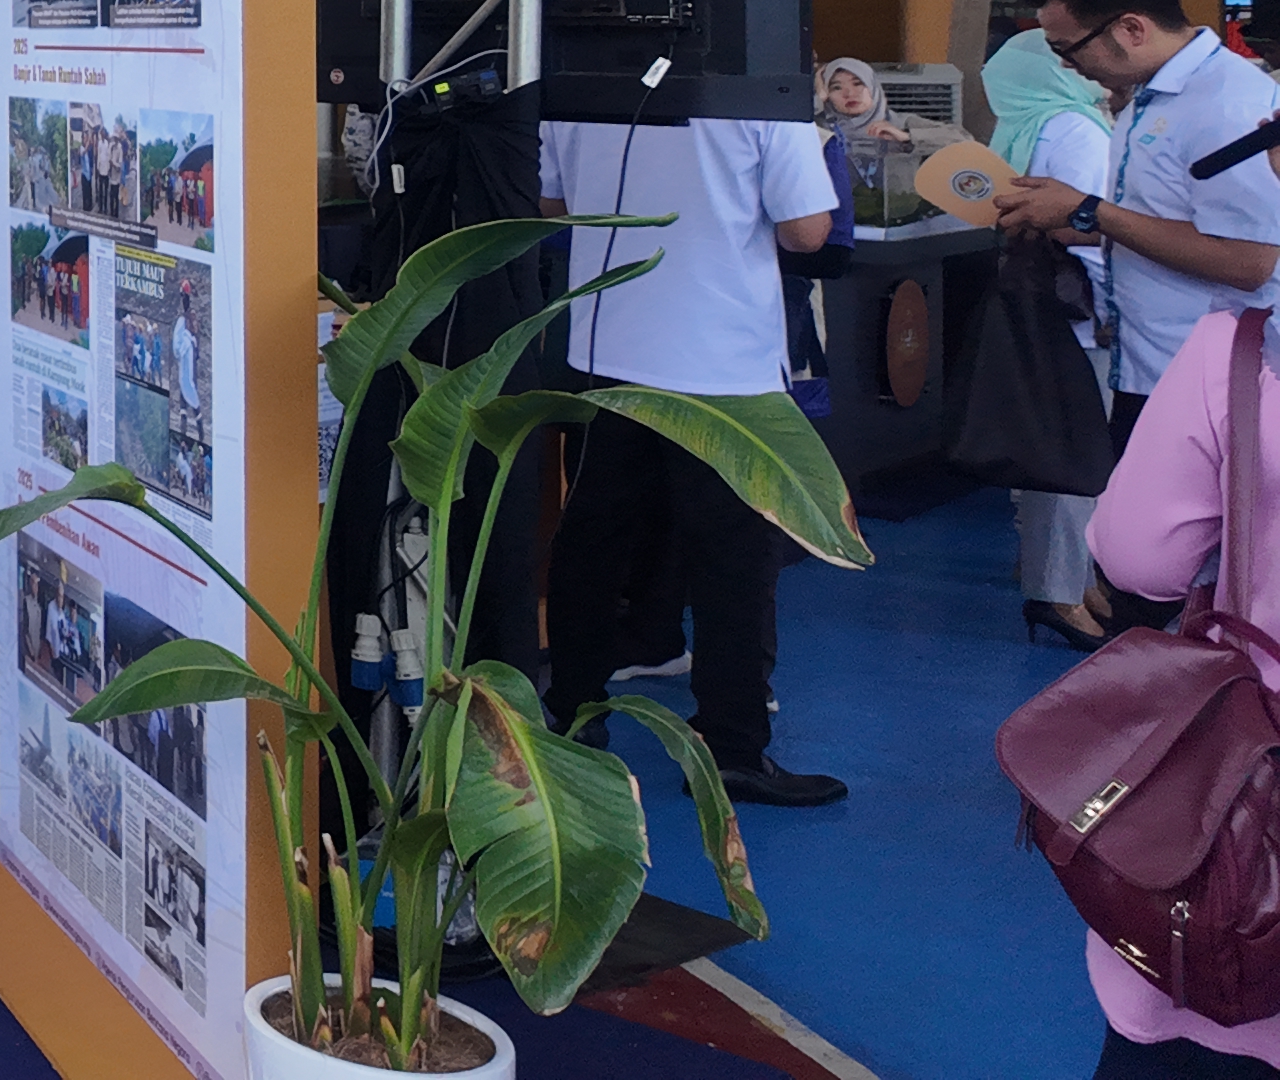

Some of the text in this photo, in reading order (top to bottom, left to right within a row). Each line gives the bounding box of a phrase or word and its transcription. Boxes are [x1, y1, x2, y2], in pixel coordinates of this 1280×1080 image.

[38, 65, 56, 82] Tanah
[58, 66, 82, 84] Runtuh
[84, 67, 106, 85] Sabah
[82, 532, 100, 558] Awan
